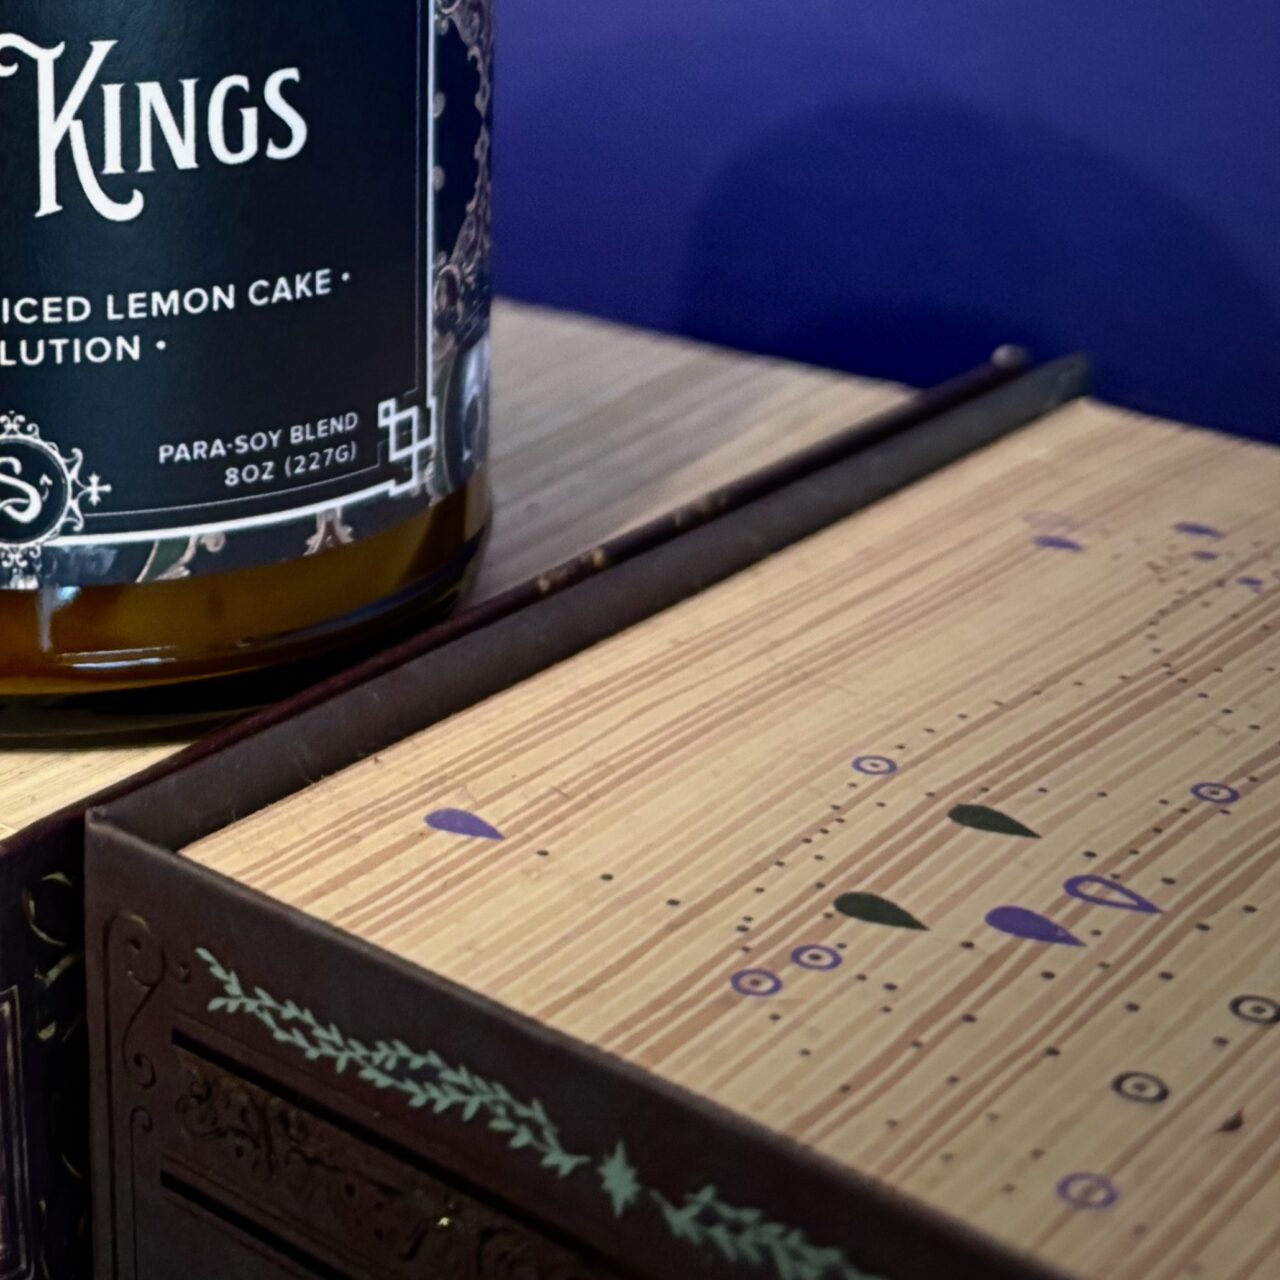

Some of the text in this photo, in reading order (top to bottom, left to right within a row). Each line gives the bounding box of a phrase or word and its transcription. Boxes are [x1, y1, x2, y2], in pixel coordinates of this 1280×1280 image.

[1, 295, 92, 325] ICED
[106, 283, 236, 322] LEMON
[247, 268, 332, 307] CAKE
[158, 412, 359, 464] PARA-SOY BLEND
[224, 440, 357, 487] 8OZ (227G)
